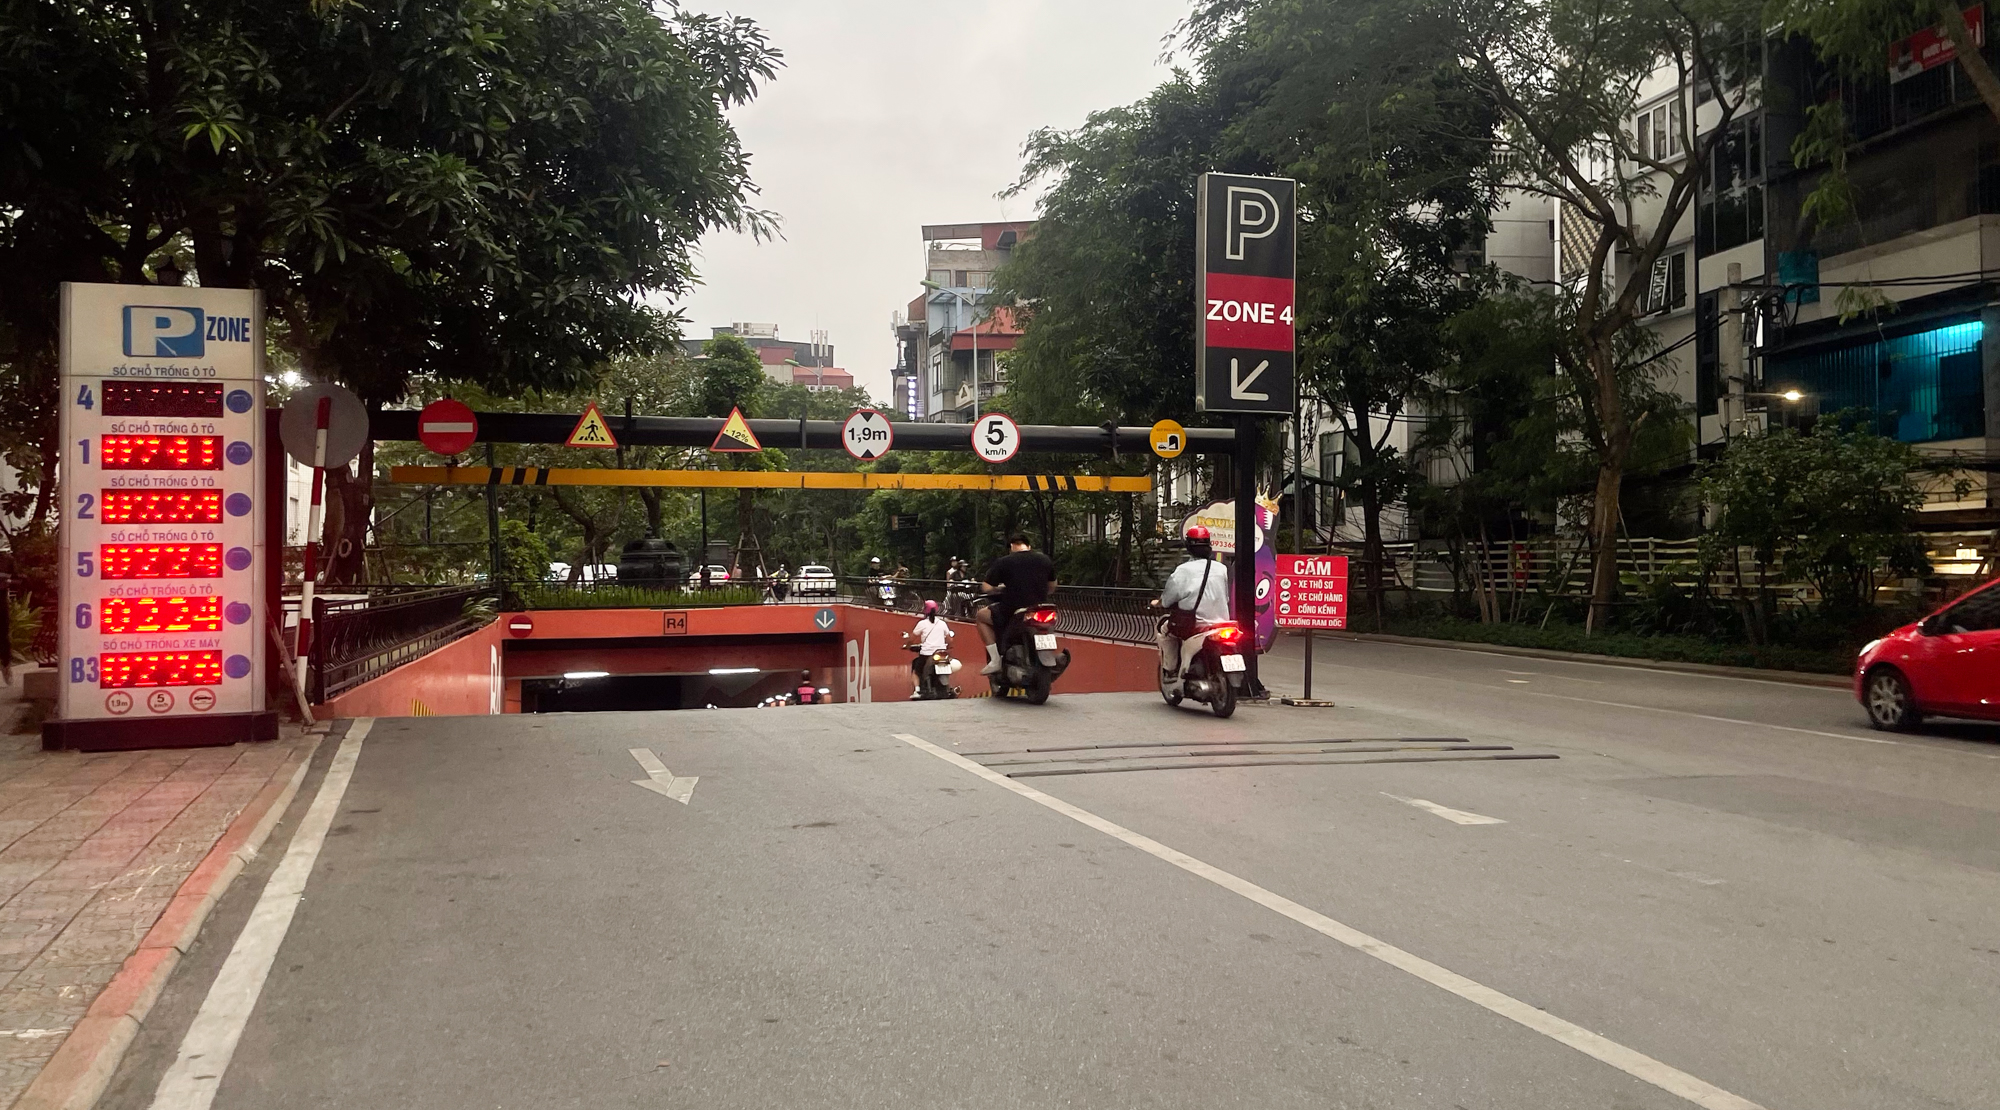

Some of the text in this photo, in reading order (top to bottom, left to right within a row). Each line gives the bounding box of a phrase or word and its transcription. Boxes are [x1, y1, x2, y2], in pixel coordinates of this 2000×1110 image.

[1226, 186, 1280, 260] P
[1206, 300, 1293, 325] ZONE 4
[206, 316, 250, 342] ZONE
[113, 365, 127, 376] SỐ
[155, 365, 189, 377] TRỐNG
[193, 366, 200, 377] Ô
[203, 366, 216, 377] TÔ
[77, 385, 94, 410] 4
[111, 422, 126, 433] SỐ
[153, 422, 188, 434] TRỐNG
[191, 423, 199, 434] Ô
[201, 423, 214, 434] TÔ
[731, 429, 749, 443] 12%
[848, 427, 887, 443] 1,9m
[987, 421, 1004, 445] 5
[78, 439, 90, 464] 1
[985, 448, 1007, 456] km/h
[111, 476, 125, 487] SỐ
[153, 476, 188, 487] TRỐNG
[191, 477, 199, 487] Ô
[201, 477, 214, 487] TÔ
[77, 494, 94, 519] 2
[201, 531, 214, 541] TÔ
[77, 552, 94, 577] 5
[1294, 557, 1331, 575] CẤM
[200, 584, 213, 594] TÔ
[1298, 580, 1307, 588] XE
[1309, 579, 1322, 588] THÔ
[1324, 580, 1334, 589] SƠ
[1298, 592, 1307, 600] XE
[1324, 592, 1343, 602] HÀNG
[75, 603, 92, 629] 6
[103, 597, 222, 631] 0224
[666, 618, 684, 629] R4
[183, 639, 196, 648] XE
[71, 657, 99, 683] B3
[846, 629, 872, 704] R4
[157, 693, 164, 703] 5
